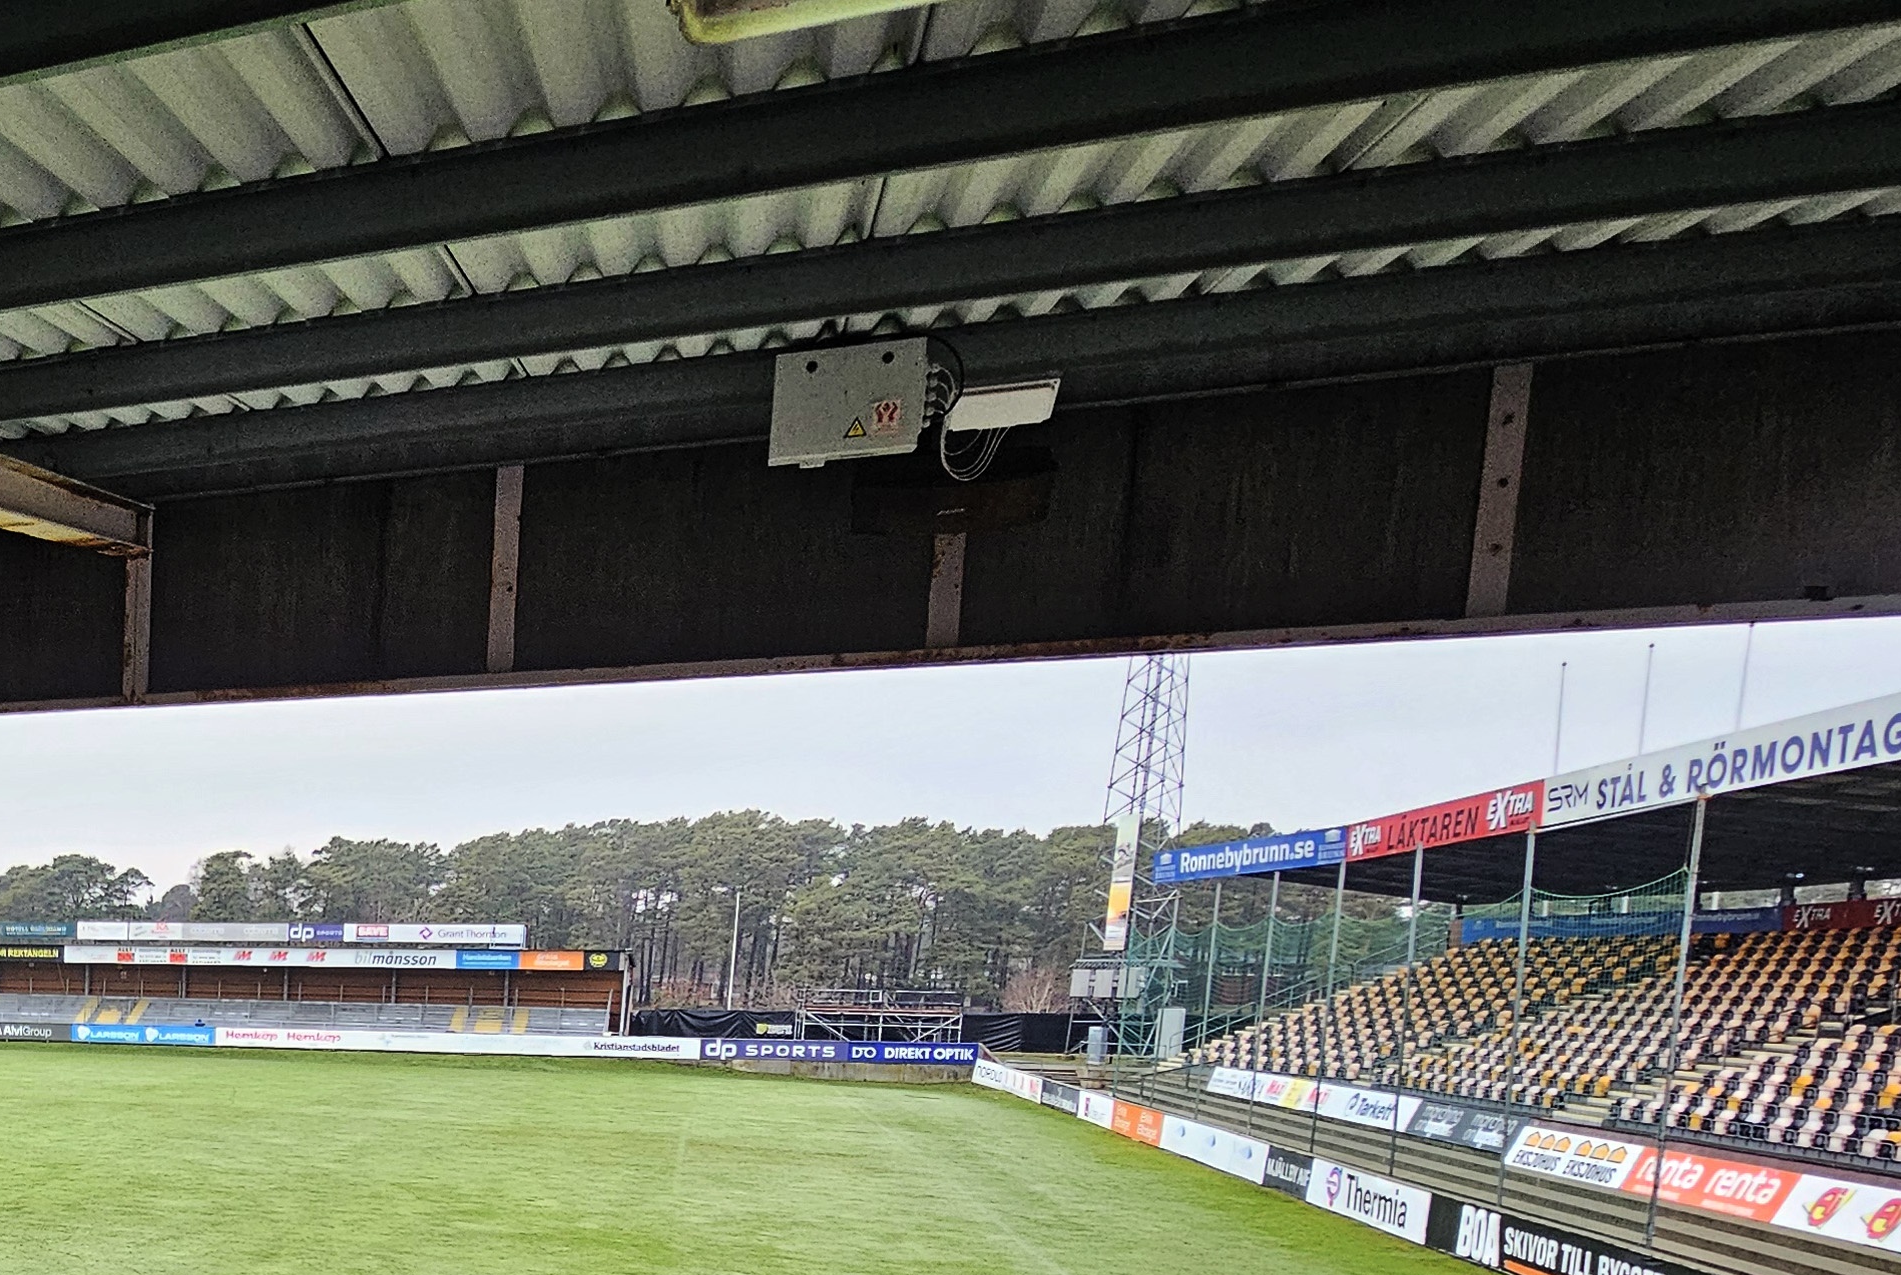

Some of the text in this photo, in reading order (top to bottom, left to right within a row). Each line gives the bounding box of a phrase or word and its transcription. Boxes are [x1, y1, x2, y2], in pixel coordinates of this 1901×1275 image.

[1548, 712, 1901, 812] SRM STÅL & RÖRMONTAG
[1180, 839, 1315, 873] Ronnebybrunn.se
[438, 929, 507, 939] Grant Thornon
[593, 1042, 680, 1052] Kristianstadsbladet
[745, 1044, 836, 1058] SPORTS
[884, 1046, 932, 1060] DIREKT
[933, 1047, 974, 1061] OPTIK
[1346, 1173, 1408, 1230] Thermia
[1704, 1166, 1782, 1205] renta
[1456, 1204, 1502, 1268] BOA
[1503, 1226, 1559, 1270] SKIVOR
